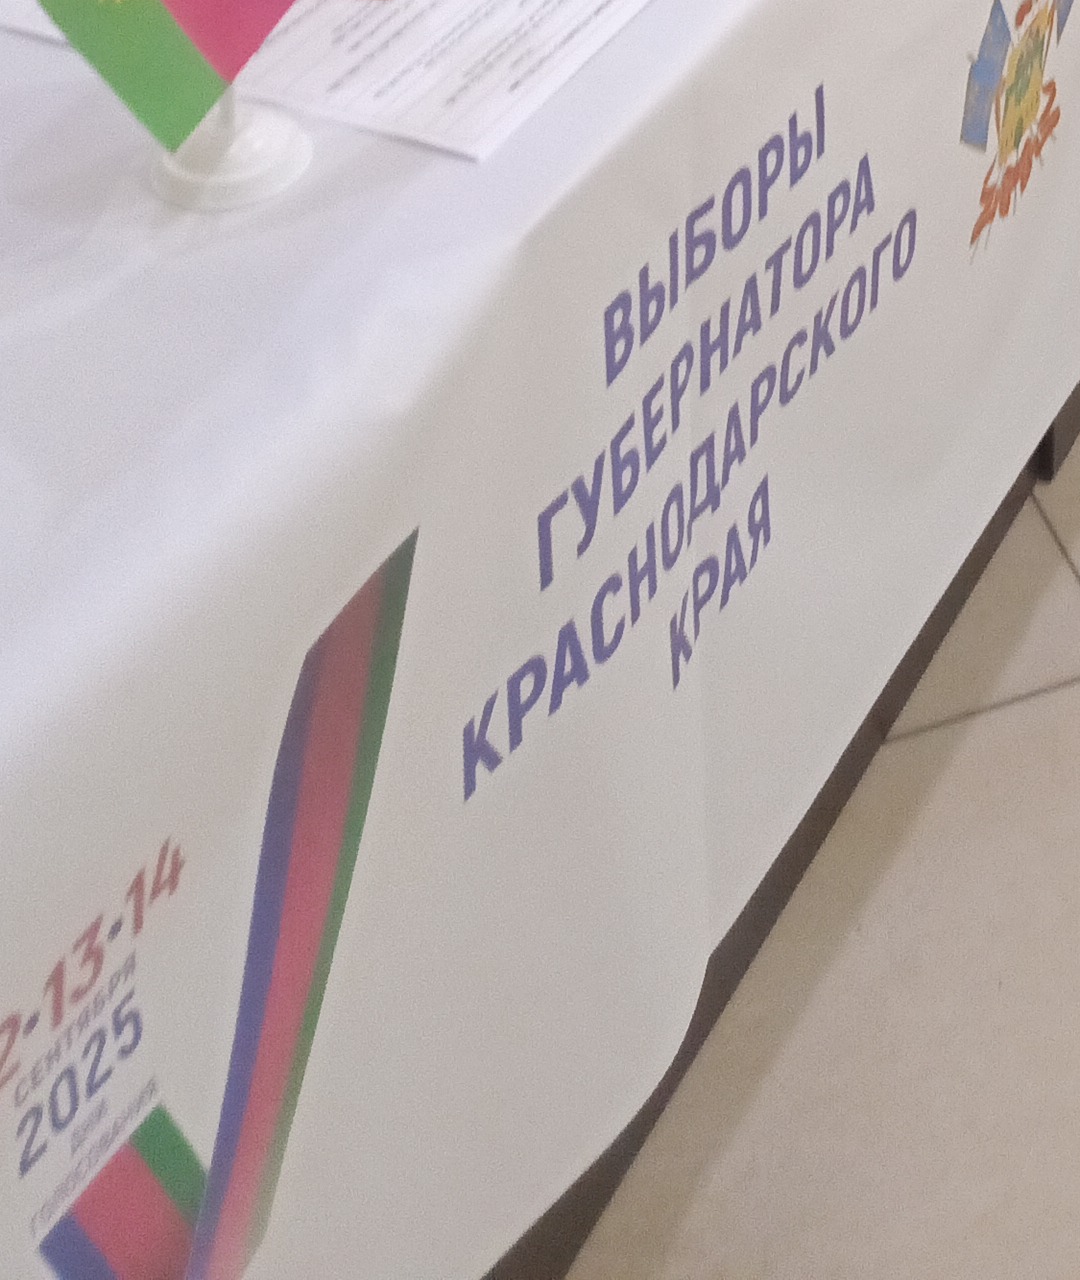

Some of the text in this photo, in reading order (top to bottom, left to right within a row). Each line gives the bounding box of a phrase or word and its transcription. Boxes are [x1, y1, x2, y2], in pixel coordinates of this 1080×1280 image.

[602, 82, 828, 388] ВЫБОРЫ
[537, 152, 877, 593] ГУБЕРНАТОРА
[462, 207, 918, 804] КРАСНОДАРСКОГО
[670, 473, 772, 690] КРАЯ
[14, 951, 137, 1108] СЕНТЯБРЯ
[16, 987, 145, 1179] 2025
